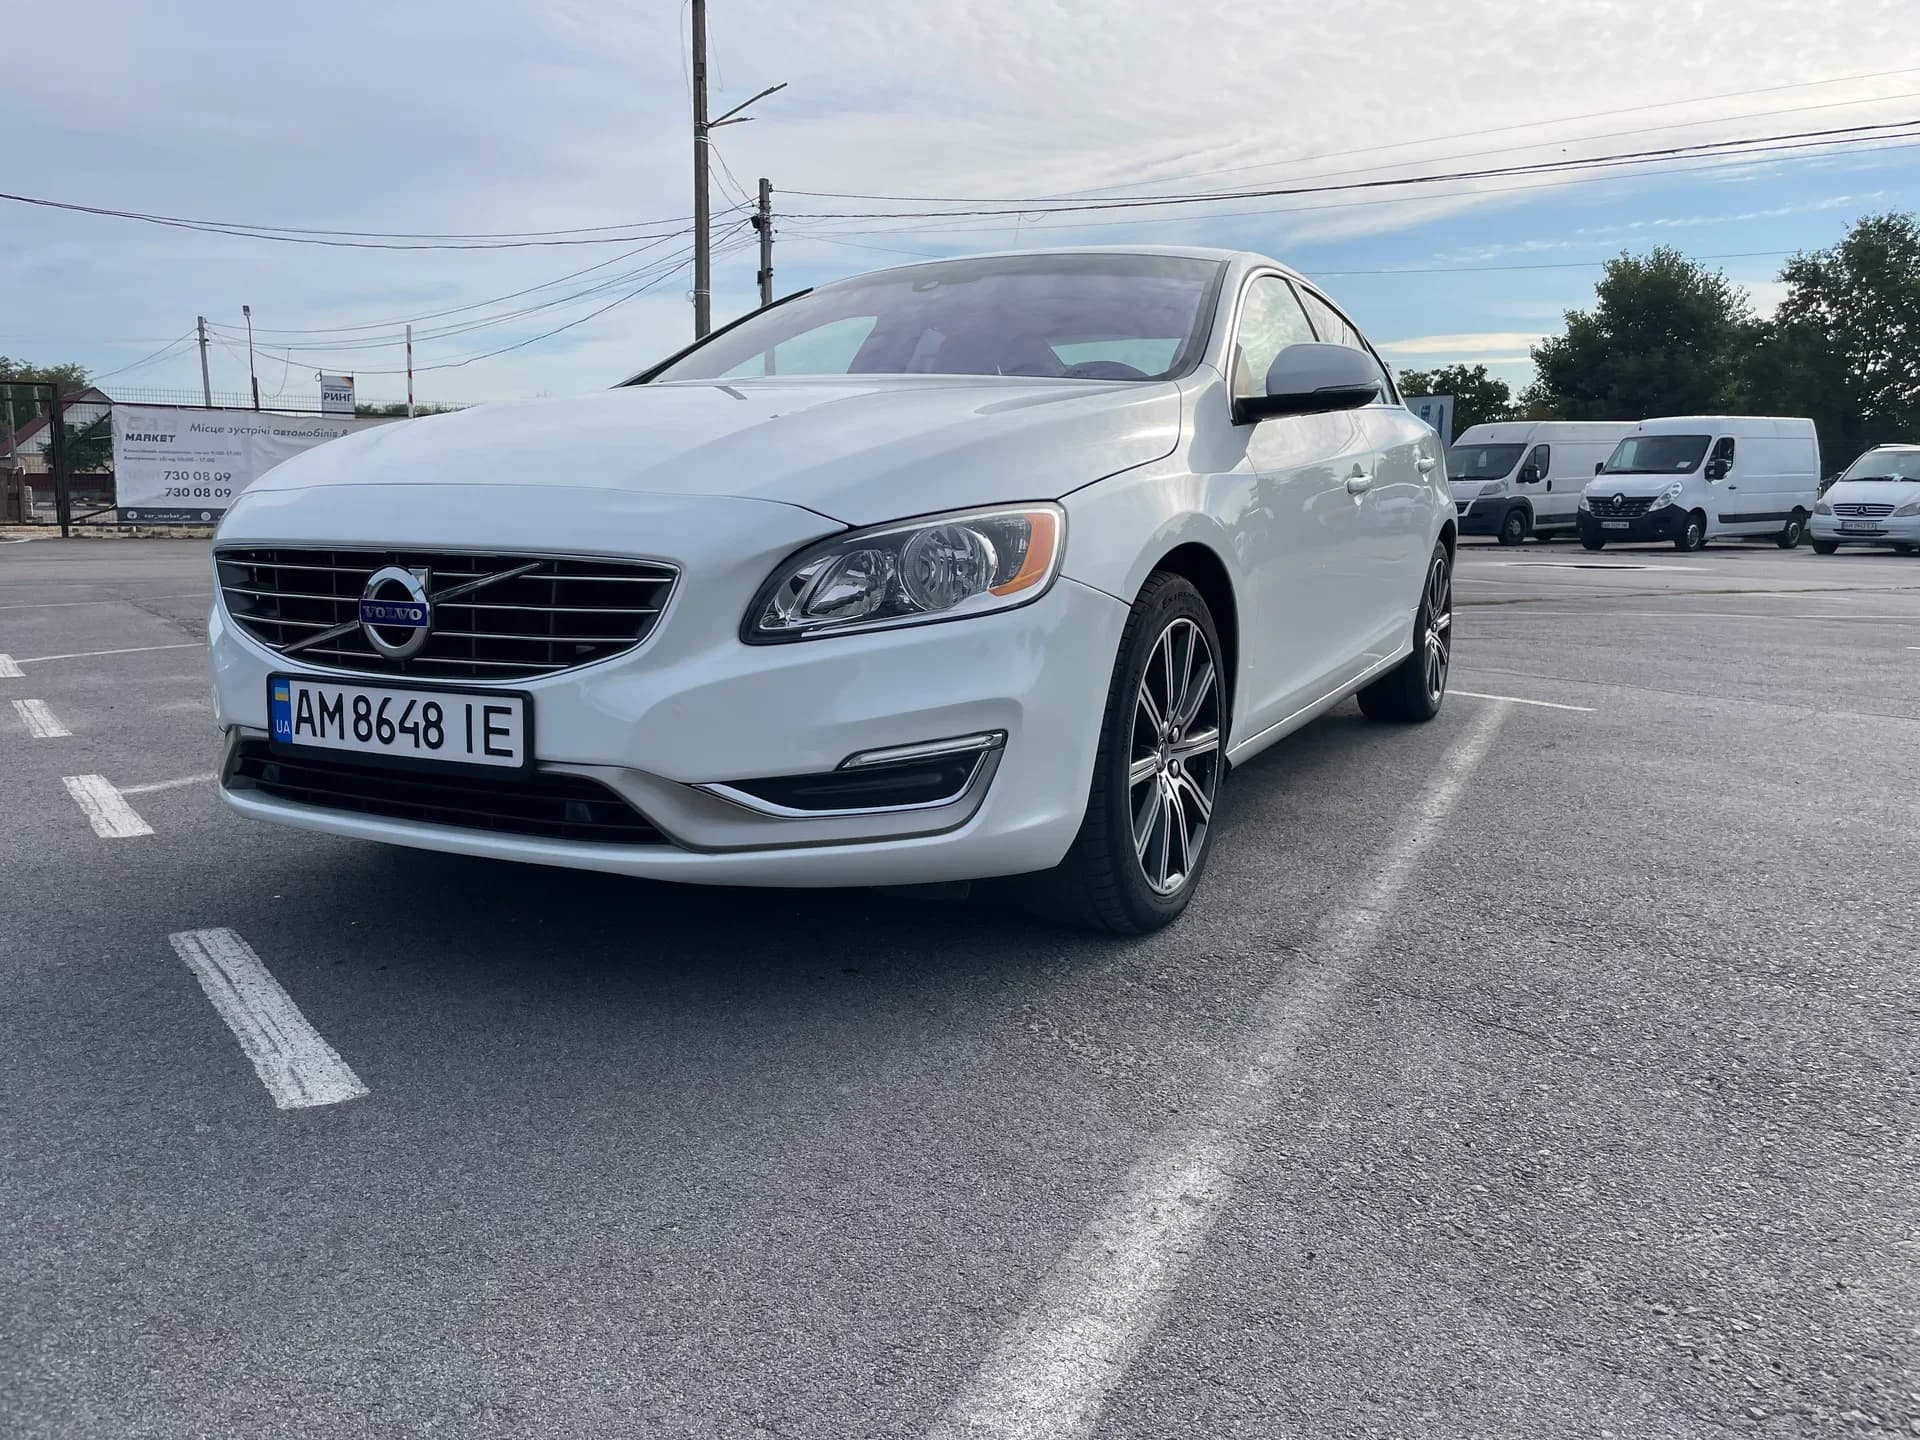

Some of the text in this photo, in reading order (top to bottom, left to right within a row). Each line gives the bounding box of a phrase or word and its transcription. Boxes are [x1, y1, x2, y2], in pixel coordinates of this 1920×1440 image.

[323, 392, 352, 402] РИНГ
[189, 423, 225, 434] Місце
[227, 425, 270, 436] зустрічі
[272, 427, 338, 438] автомобілів
[125, 433, 176, 443] MARKET
[163, 471, 189, 481] 730
[193, 471, 210, 481] 08
[214, 472, 232, 482] 09
[165, 488, 232, 498] 730 08 09
[362, 605, 423, 621] VOLVO
[275, 718, 291, 735] UA
[295, 688, 514, 758] AM 8648 IE
